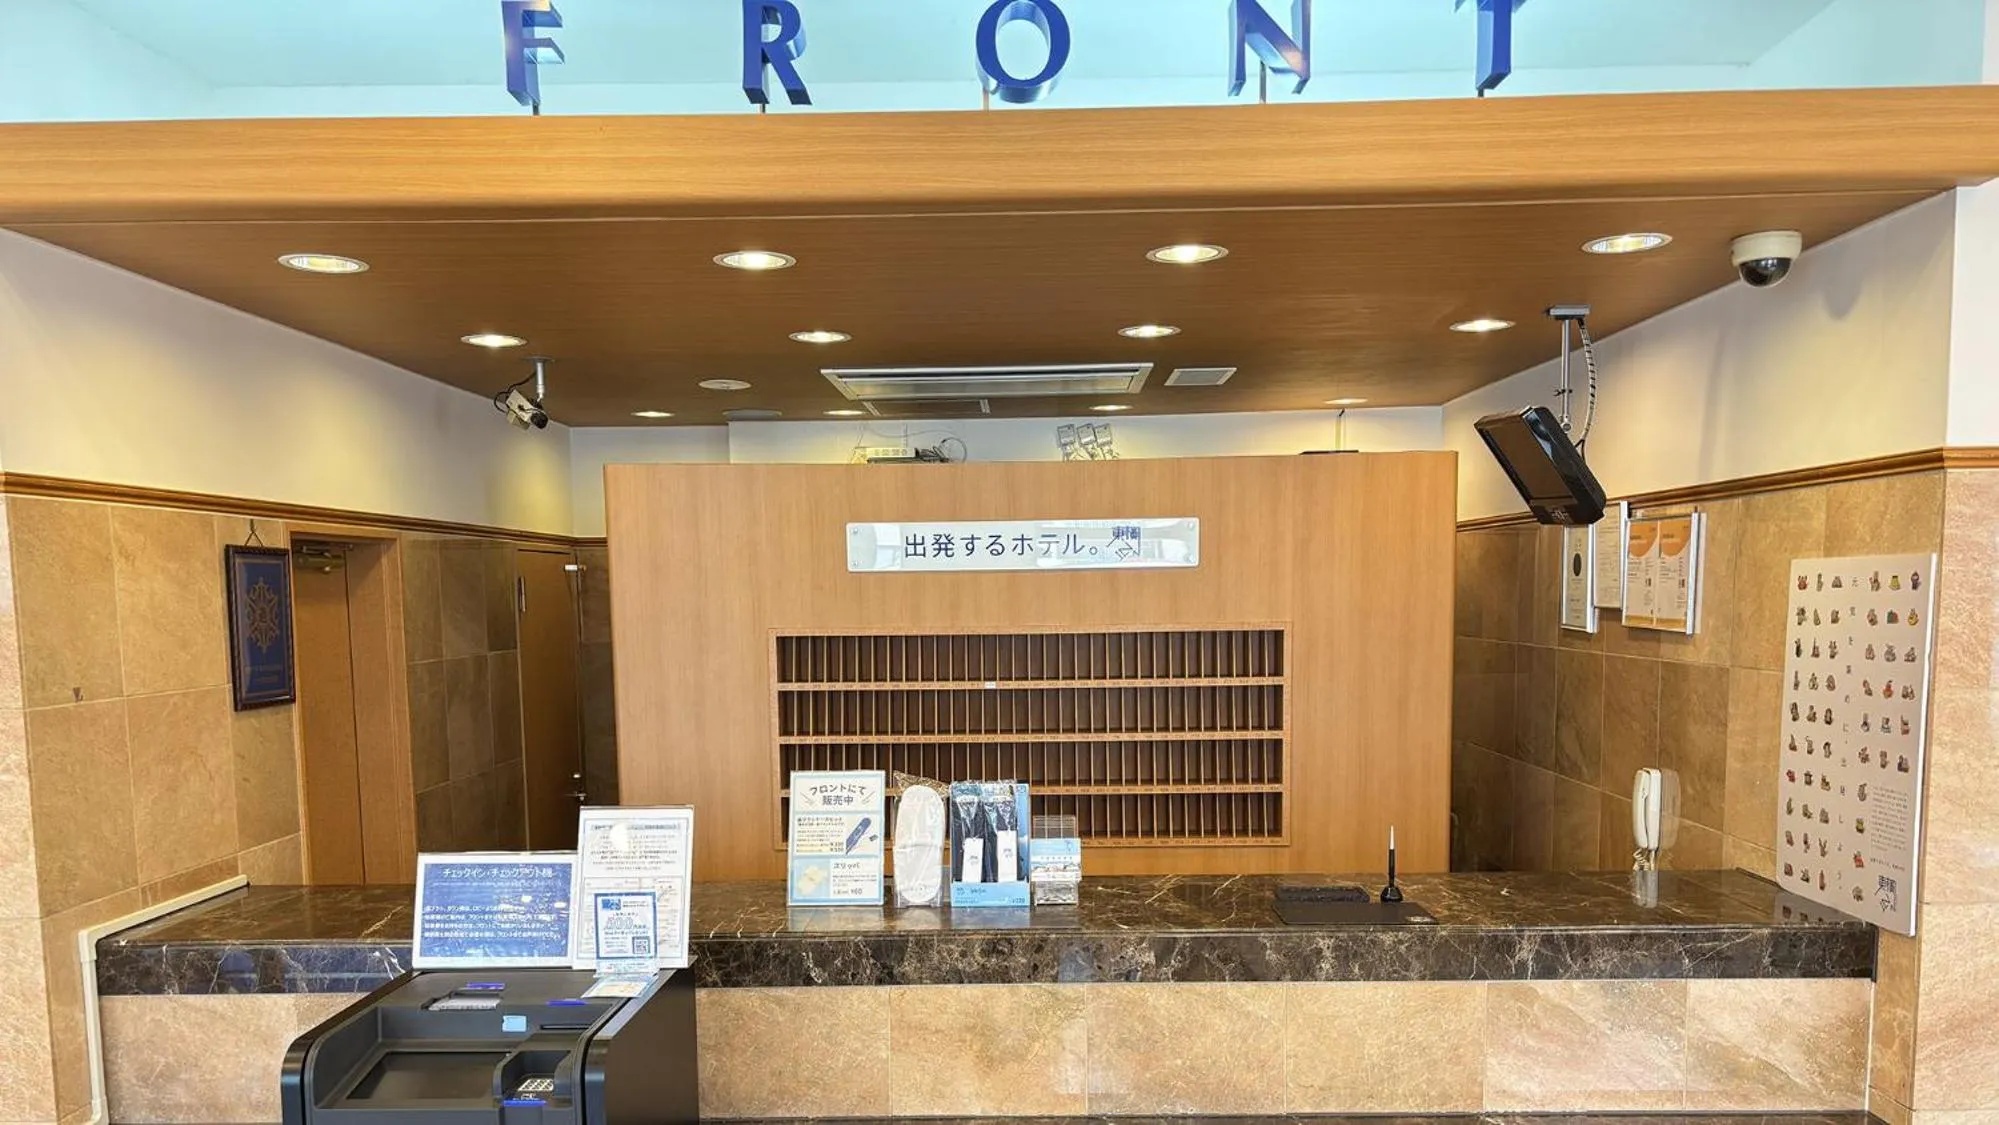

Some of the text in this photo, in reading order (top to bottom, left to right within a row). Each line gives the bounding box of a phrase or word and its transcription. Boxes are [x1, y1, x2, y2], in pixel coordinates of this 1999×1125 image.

[502, 0, 1526, 104] FRONT
[905, 532, 1098, 559] 出発するホテル。
[809, 784, 866, 796] フロントにて
[822, 795, 854, 806] 販売中
